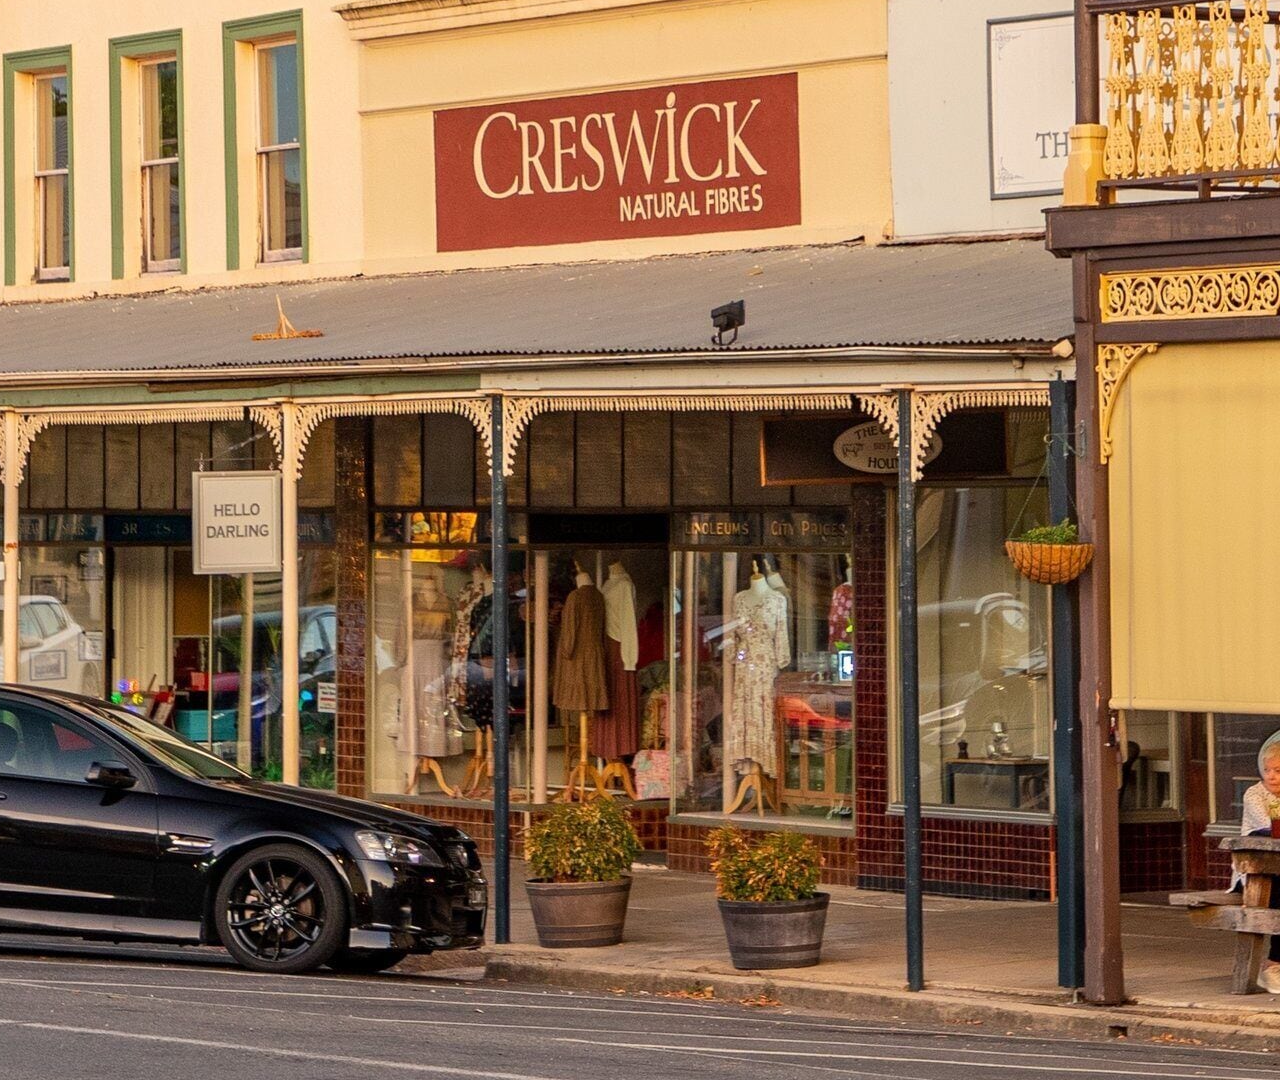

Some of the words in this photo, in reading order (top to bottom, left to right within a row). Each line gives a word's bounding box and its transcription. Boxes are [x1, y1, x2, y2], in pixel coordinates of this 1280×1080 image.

[473, 91, 768, 200] CRESWICK
[1035, 129, 1069, 160] TH
[619, 190, 701, 222] NATURAL
[705, 183, 764, 216] FIBRES
[213, 502, 261, 517] HELLO
[206, 523, 270, 539] DARLING
